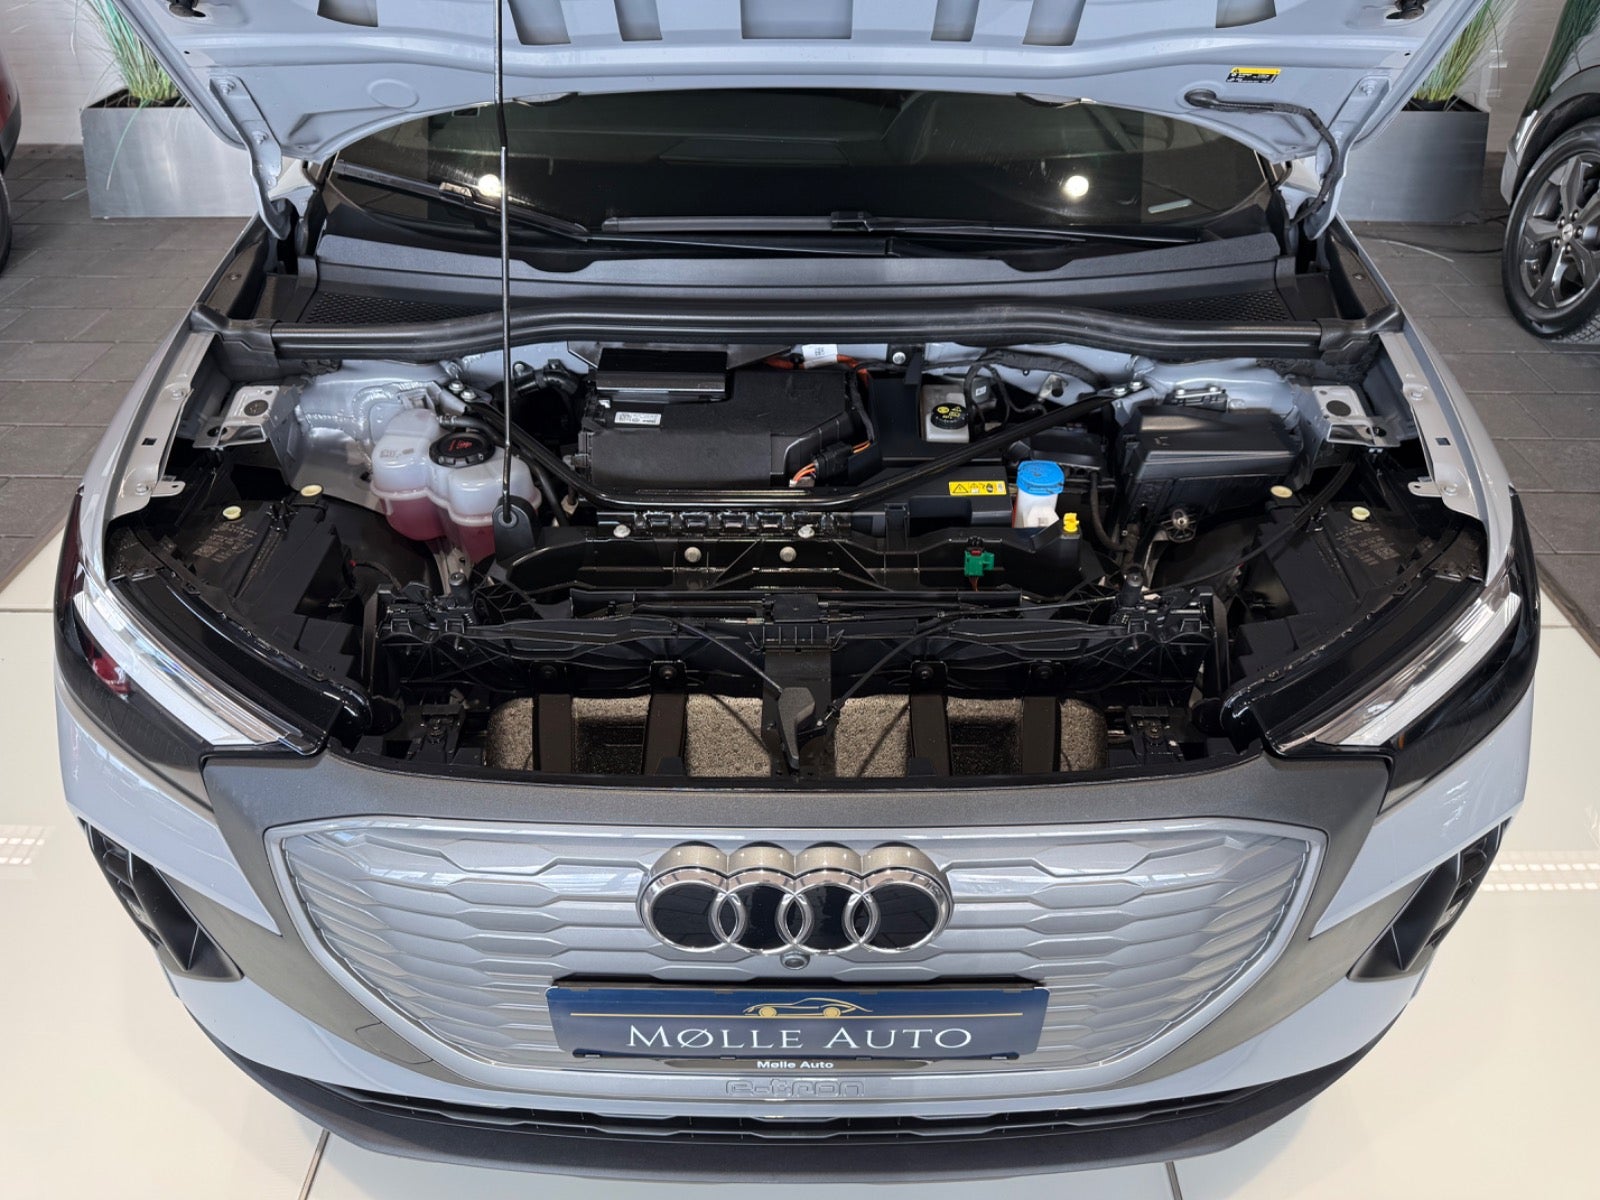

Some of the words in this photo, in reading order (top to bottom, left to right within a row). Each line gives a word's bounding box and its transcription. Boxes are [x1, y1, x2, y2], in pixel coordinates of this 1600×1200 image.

[626, 1024, 804, 1048] MØLLE
[823, 1026, 972, 1049] AUTO
[756, 1060, 796, 1069] Mølle
[800, 1060, 834, 1069] Auto
[725, 1079, 865, 1098] e-tron
